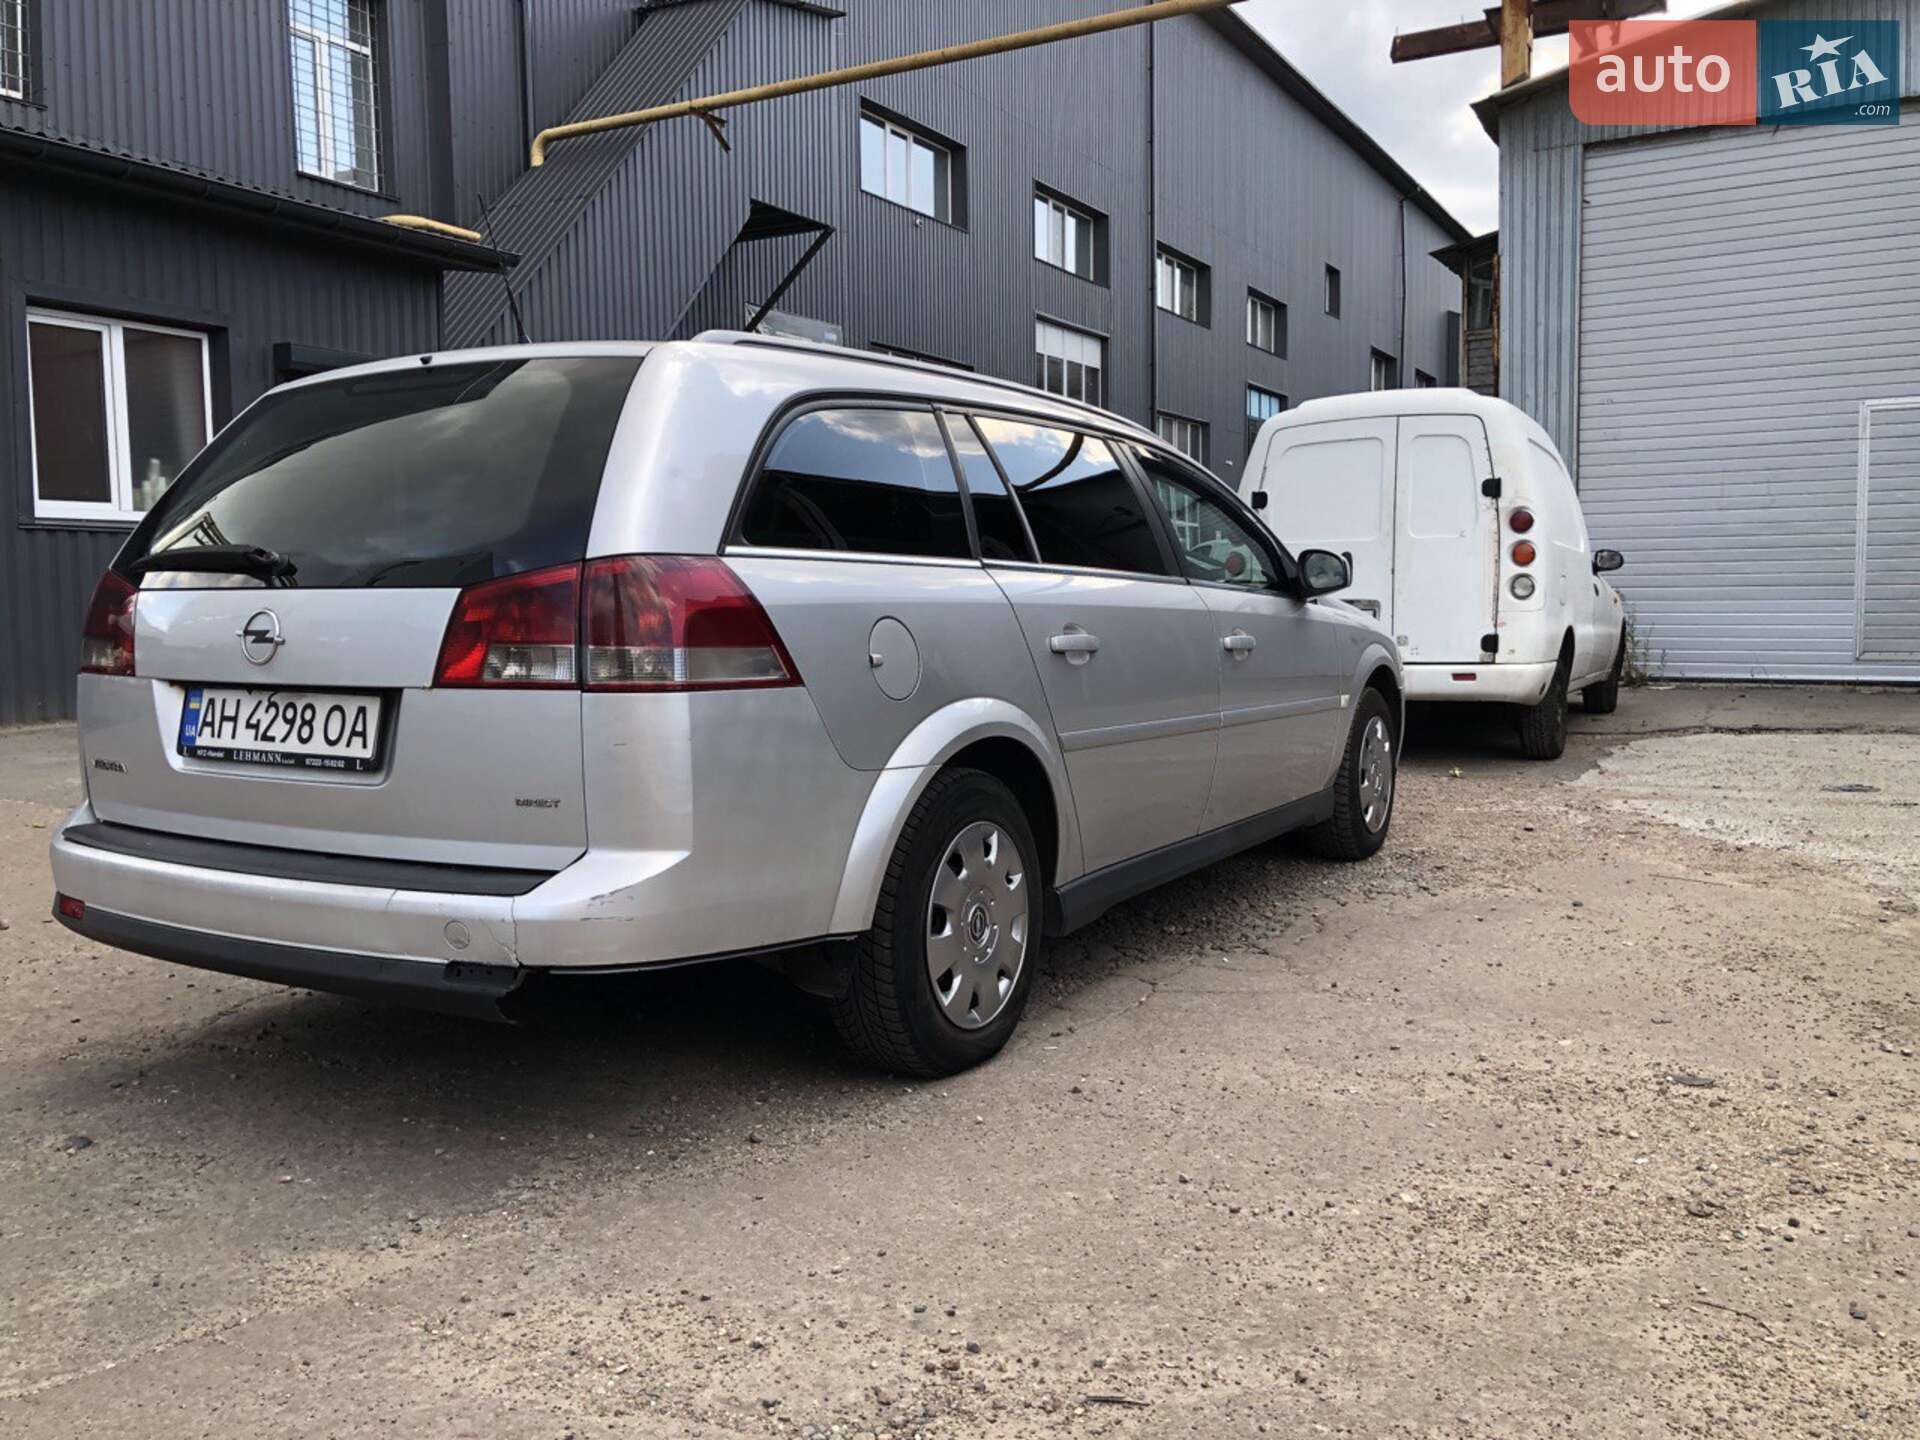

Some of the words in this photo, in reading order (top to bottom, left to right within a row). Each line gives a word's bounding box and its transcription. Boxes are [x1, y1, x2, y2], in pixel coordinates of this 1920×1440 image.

[198, 697, 241, 740] AH
[245, 699, 317, 745] 4298
[323, 704, 368, 749] OA
[185, 724, 197, 737] UA
[233, 750, 282, 764] LEHMANN
